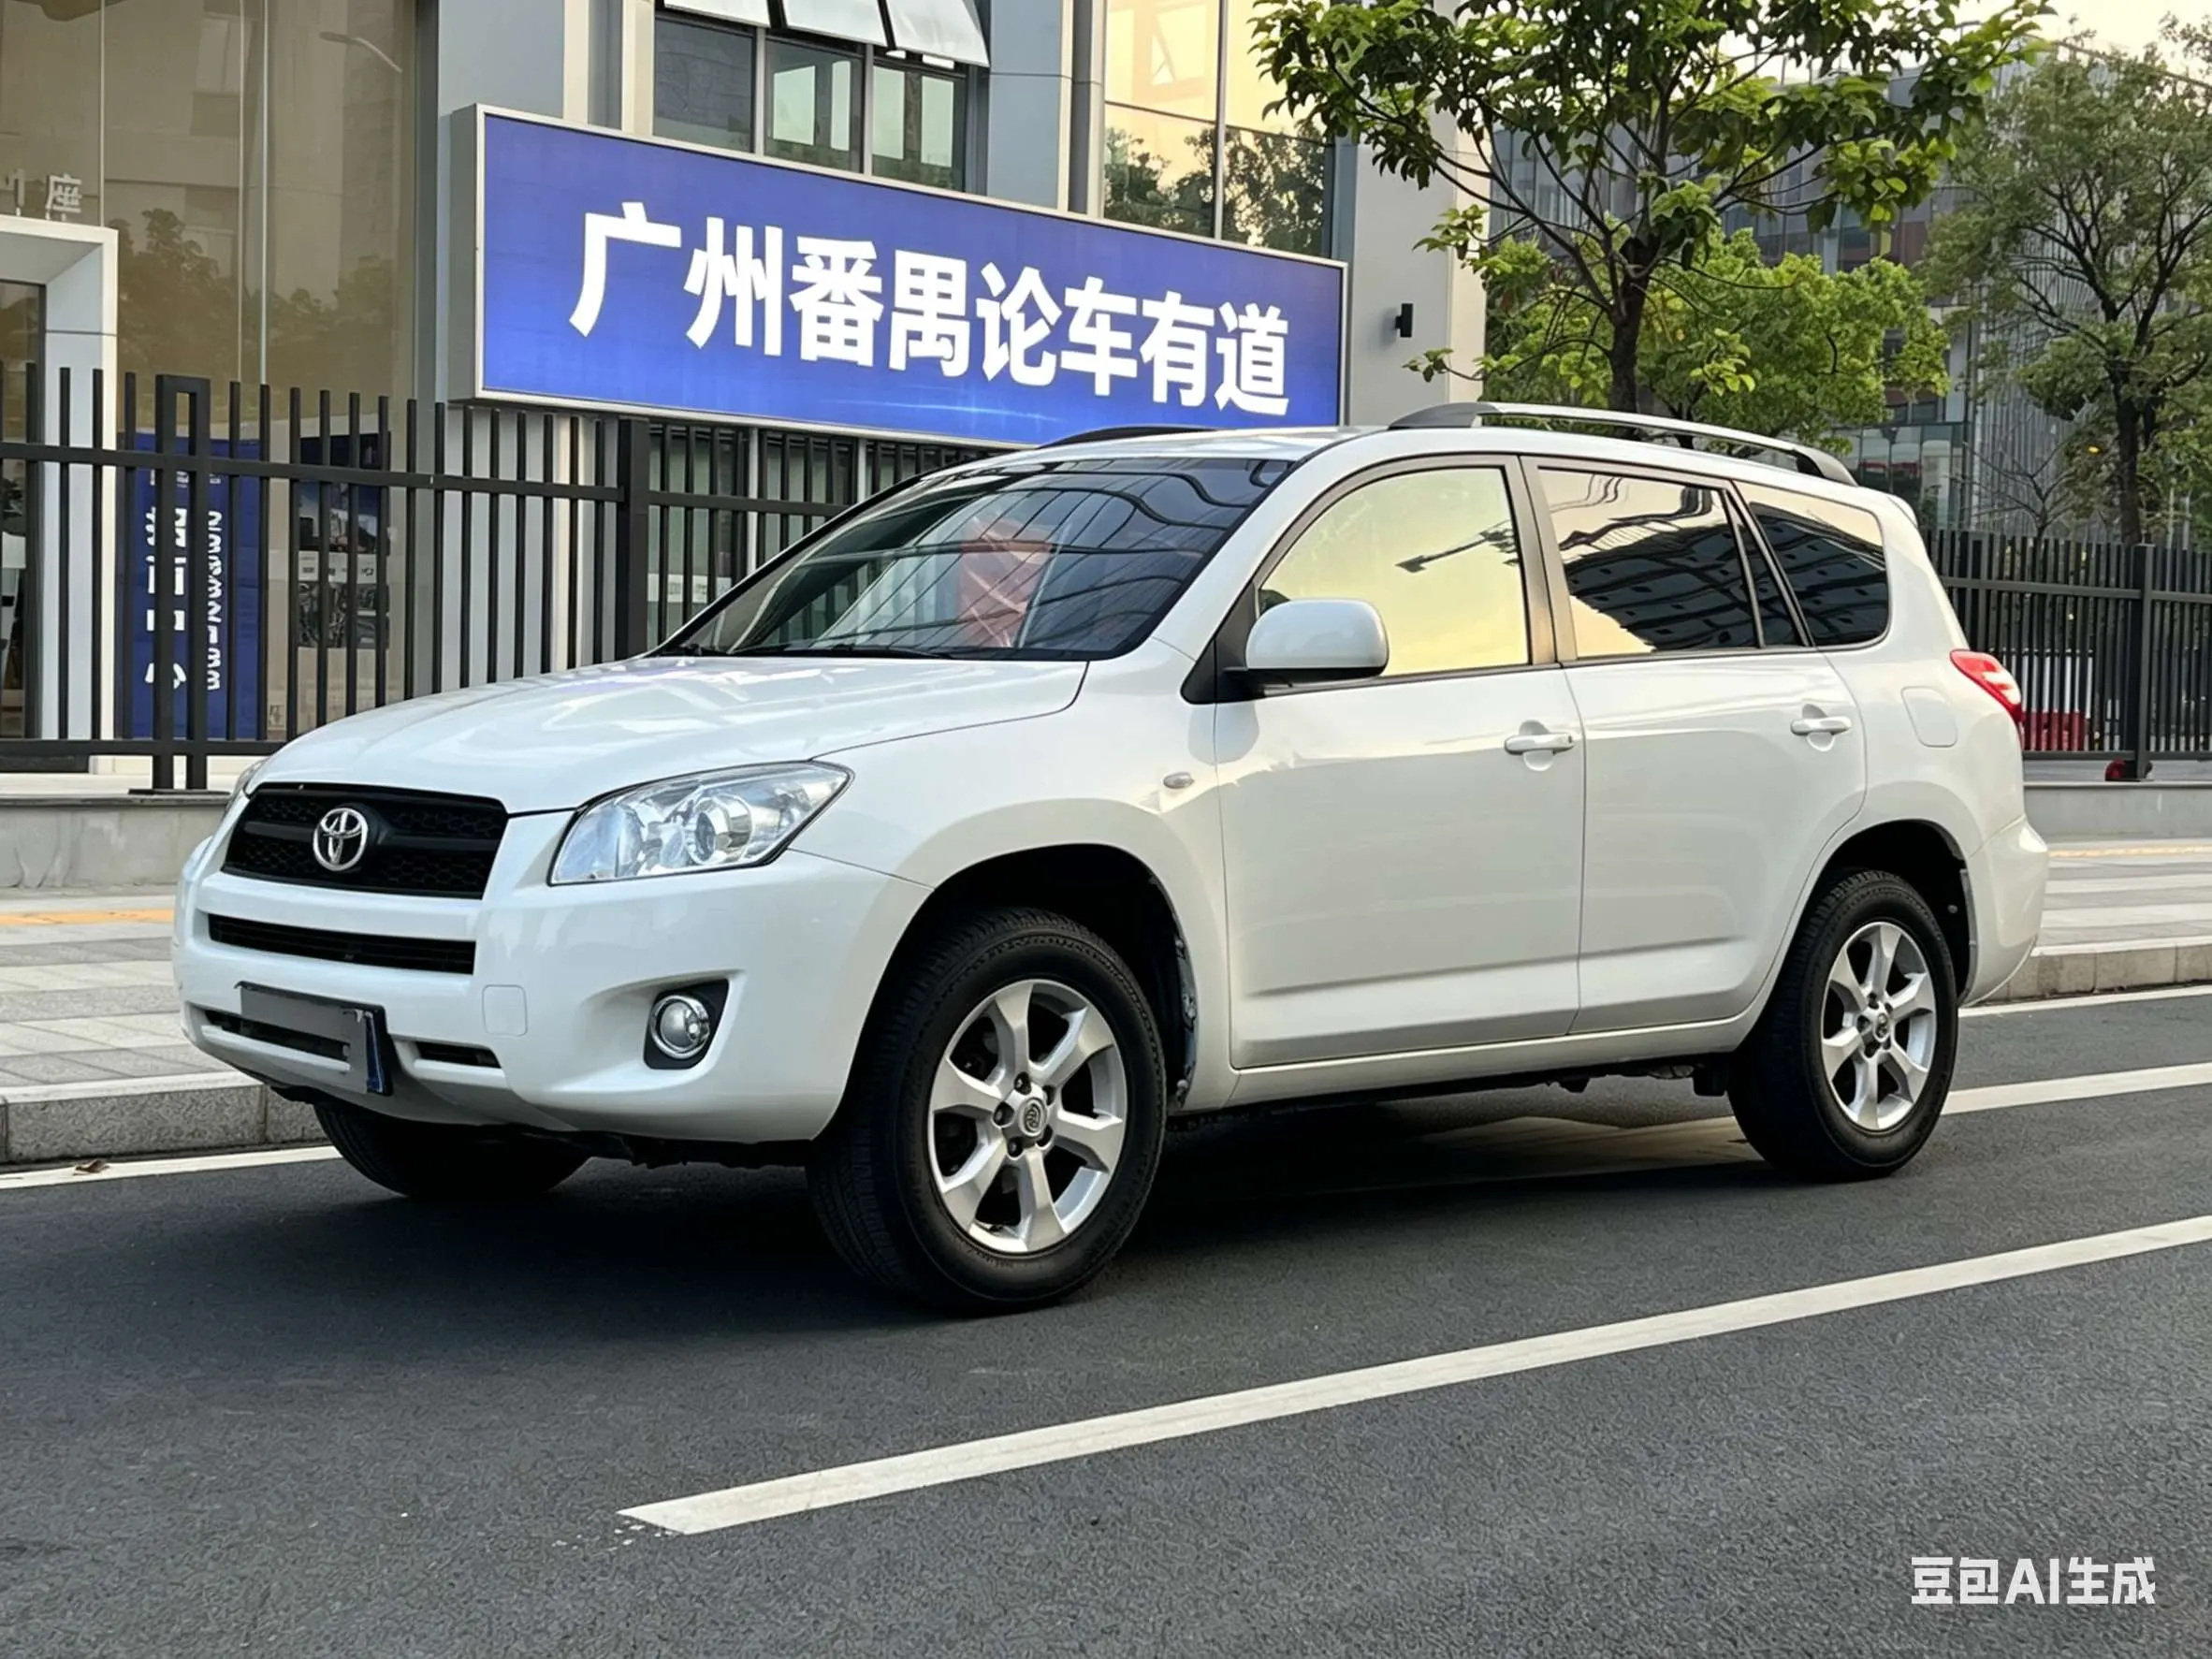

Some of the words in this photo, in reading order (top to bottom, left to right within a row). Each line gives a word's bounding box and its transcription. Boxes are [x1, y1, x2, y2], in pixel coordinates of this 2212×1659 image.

[569, 202, 1288, 415] 广州番禺论车有道
